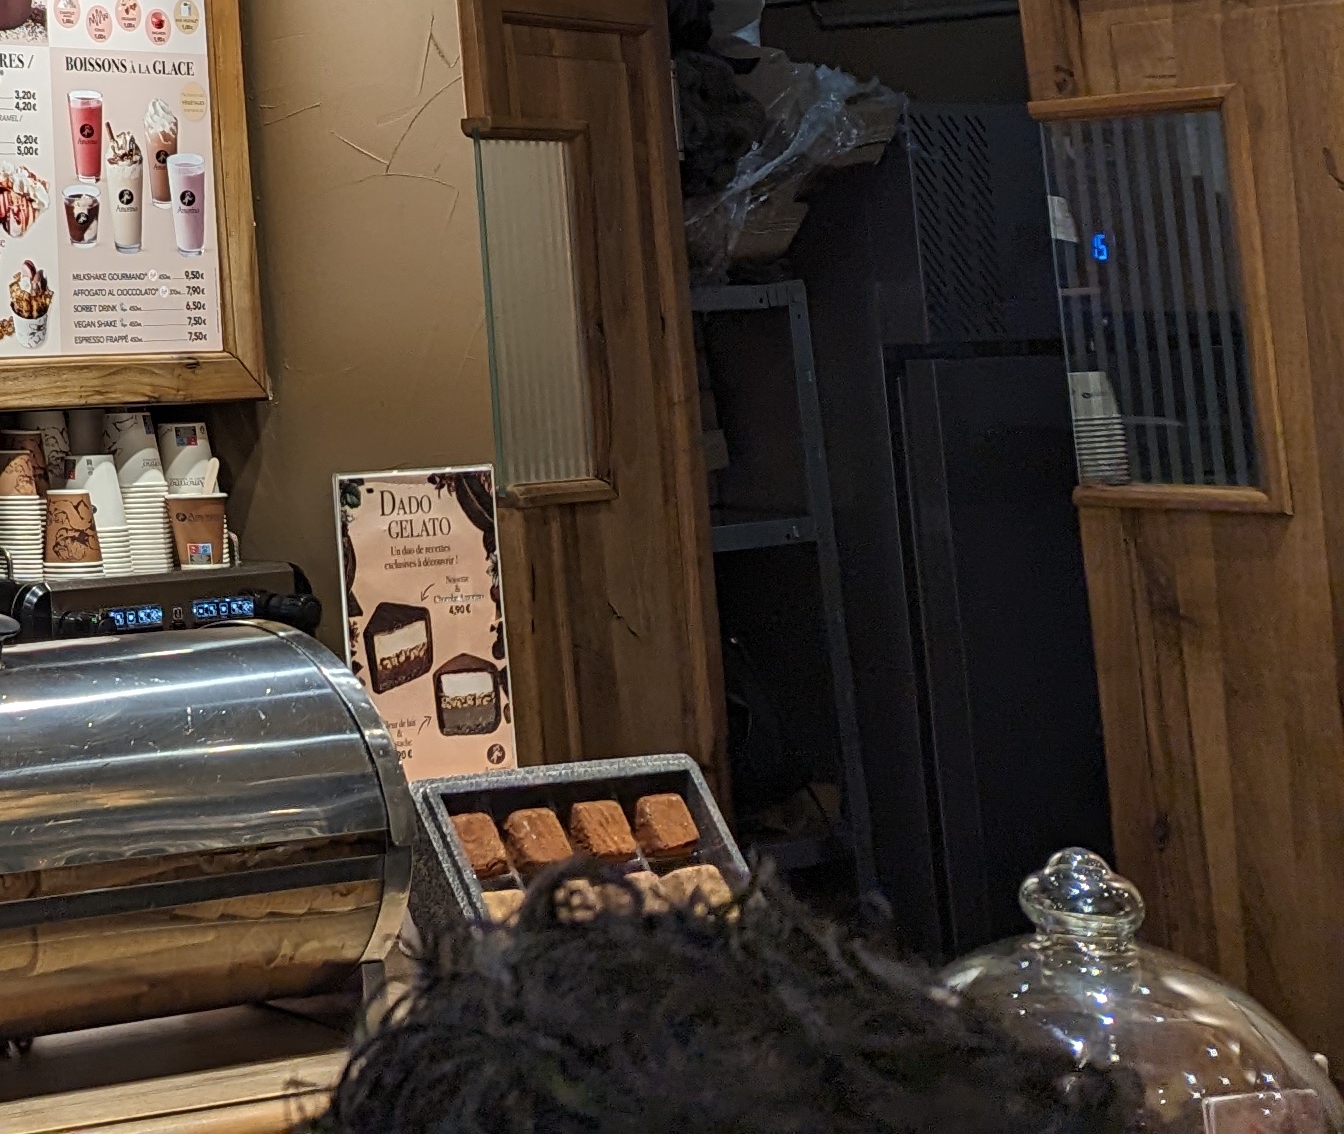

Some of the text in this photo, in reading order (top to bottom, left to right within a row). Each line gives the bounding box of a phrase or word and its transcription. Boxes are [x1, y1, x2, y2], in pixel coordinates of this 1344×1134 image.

[65, 56, 195, 77] BOISSONS LA GLACE
[73, 288, 106, 297] AFFOGATO
[73, 320, 96, 328] VEGAN
[379, 489, 432, 517] DADO
[388, 517, 452, 540] GELATO
[416, 544, 424, 554] de
